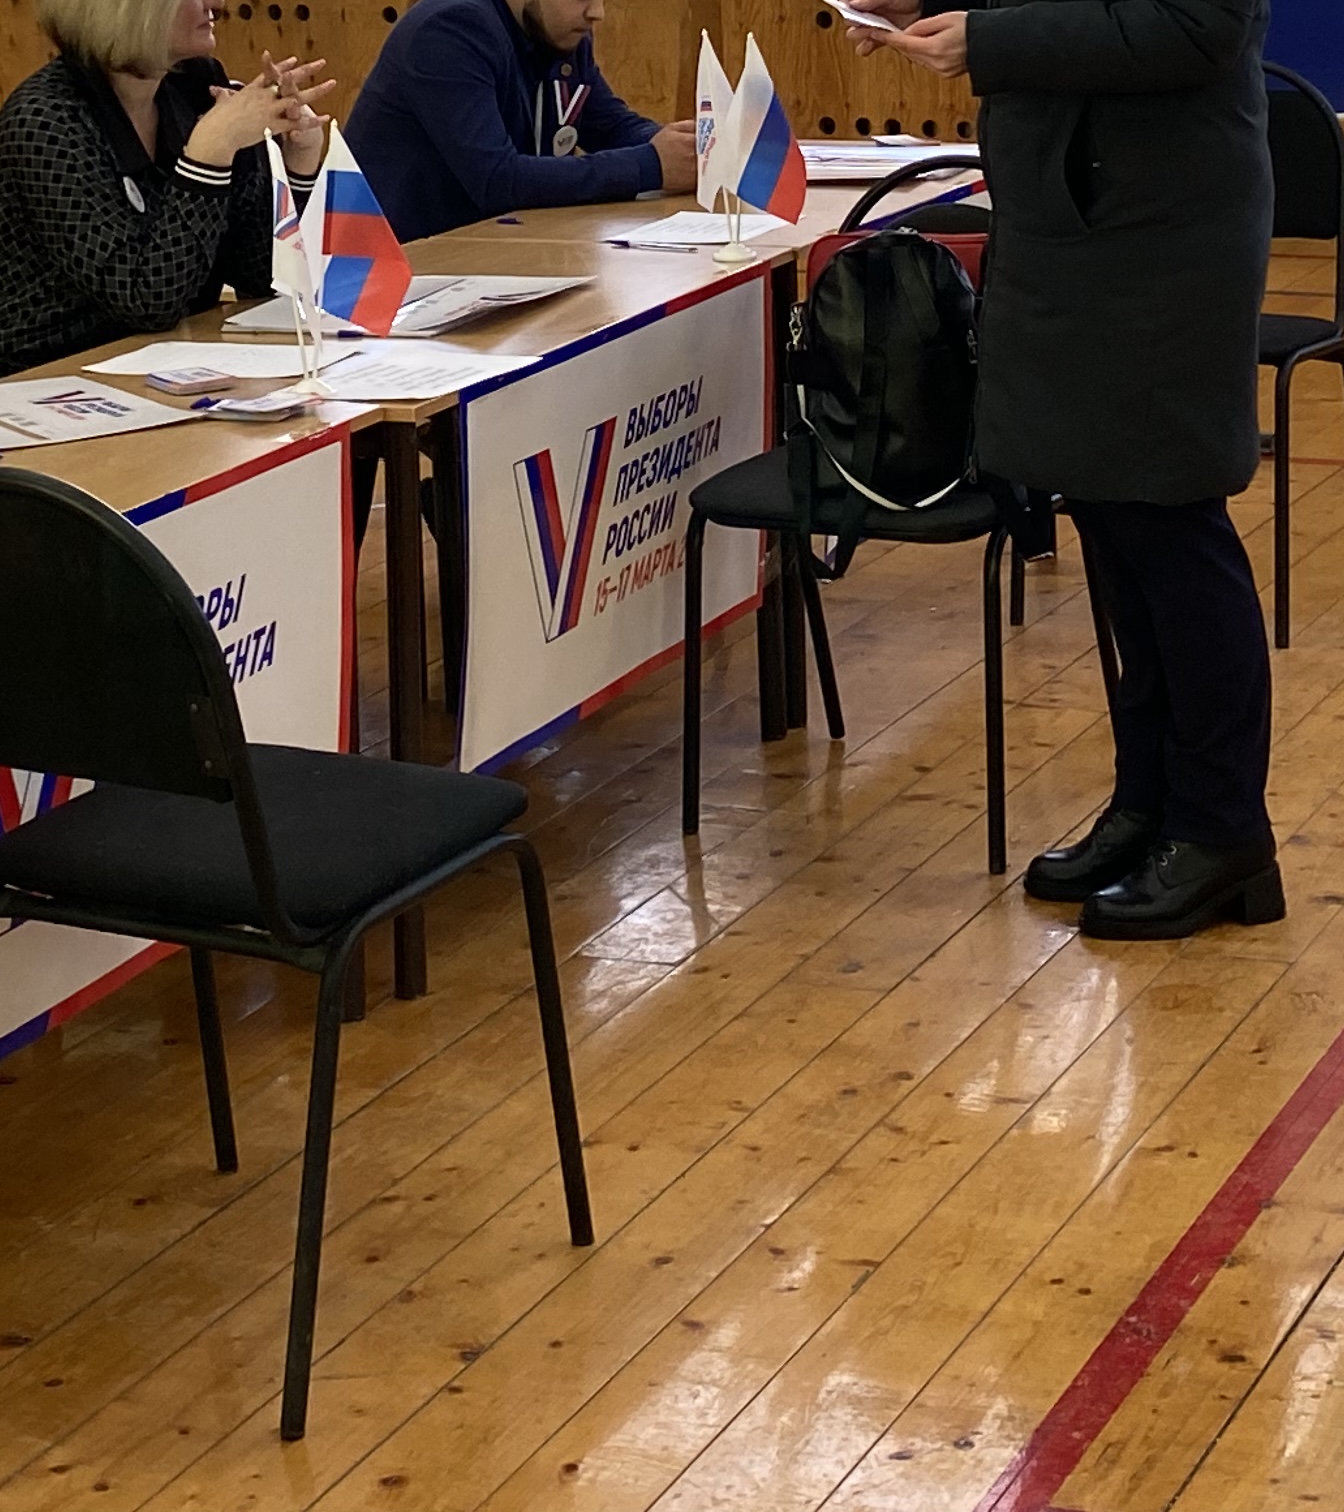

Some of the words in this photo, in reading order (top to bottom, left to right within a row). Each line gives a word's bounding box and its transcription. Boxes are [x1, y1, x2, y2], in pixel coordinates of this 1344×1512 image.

[623, 375, 704, 449] ВЫБОРЫ
[612, 416, 722, 507] ПРЕЗИДЕНТА
[602, 490, 678, 566] РОССИИ
[630, 540, 676, 594] МАРТА
